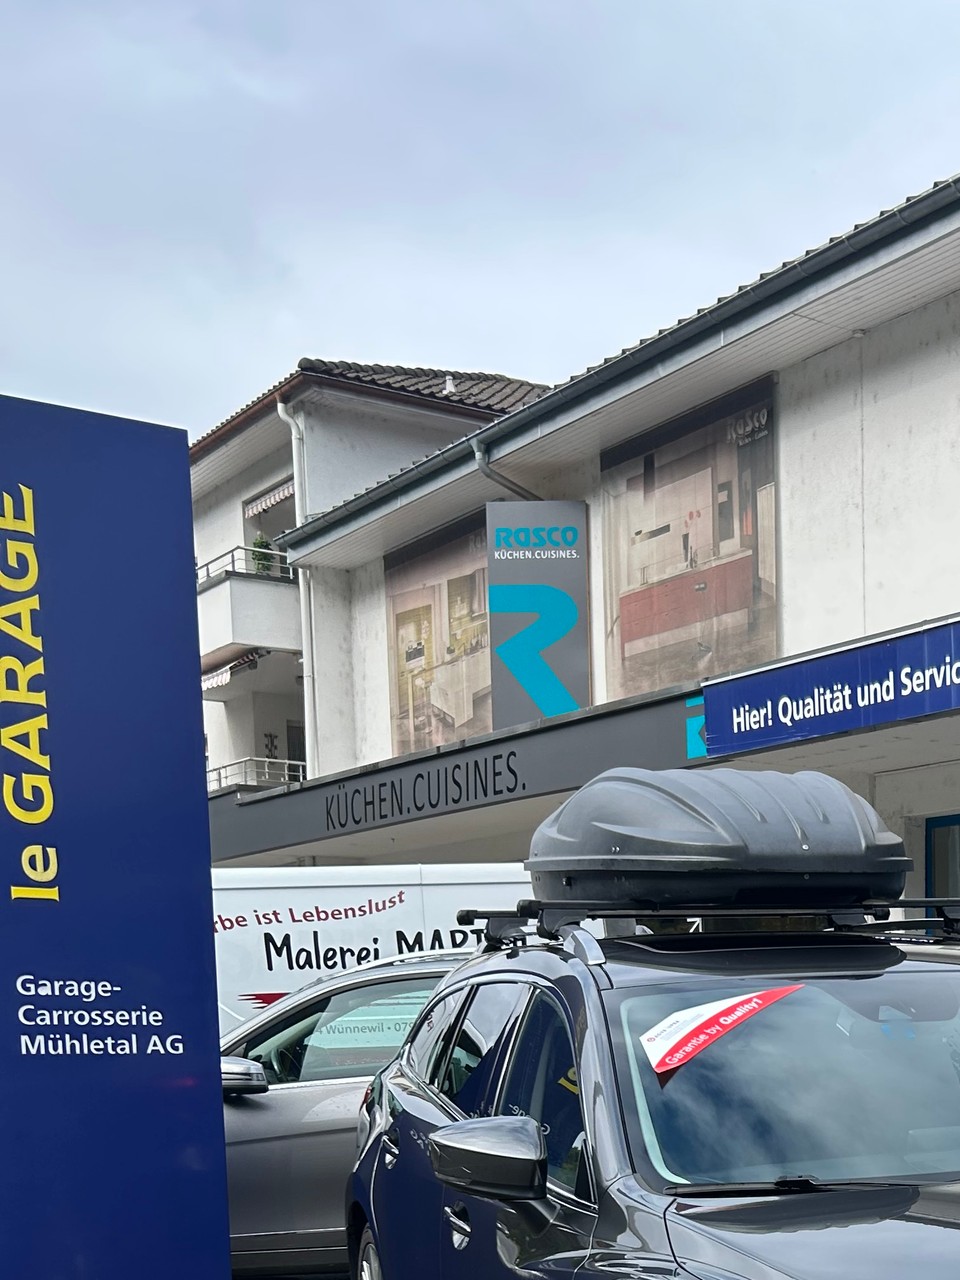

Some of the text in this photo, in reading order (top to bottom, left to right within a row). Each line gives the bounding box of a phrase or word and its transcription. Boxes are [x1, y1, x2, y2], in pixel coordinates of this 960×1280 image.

[0, 483, 60, 902] le GARAGE
[732, 700, 773, 733] Hier!
[778, 682, 852, 726] Qualität
[857, 671, 895, 707] und
[326, 751, 527, 832] KÜCHEN.CUISINES.
[253, 909, 283, 926] ist
[288, 889, 406, 924] Lebenslust
[263, 930, 382, 972] Malerei
[15, 974, 122, 1002] Garage-
[17, 1004, 164, 1026] Carrosserie
[325, 1022, 385, 1035] Wünnewil
[665, 1032, 709, 1065] Garantie
[704, 1023, 724, 1038] by
[719, 997, 763, 1025] Quality1
[20, 1033, 184, 1055] Mühletal AG
